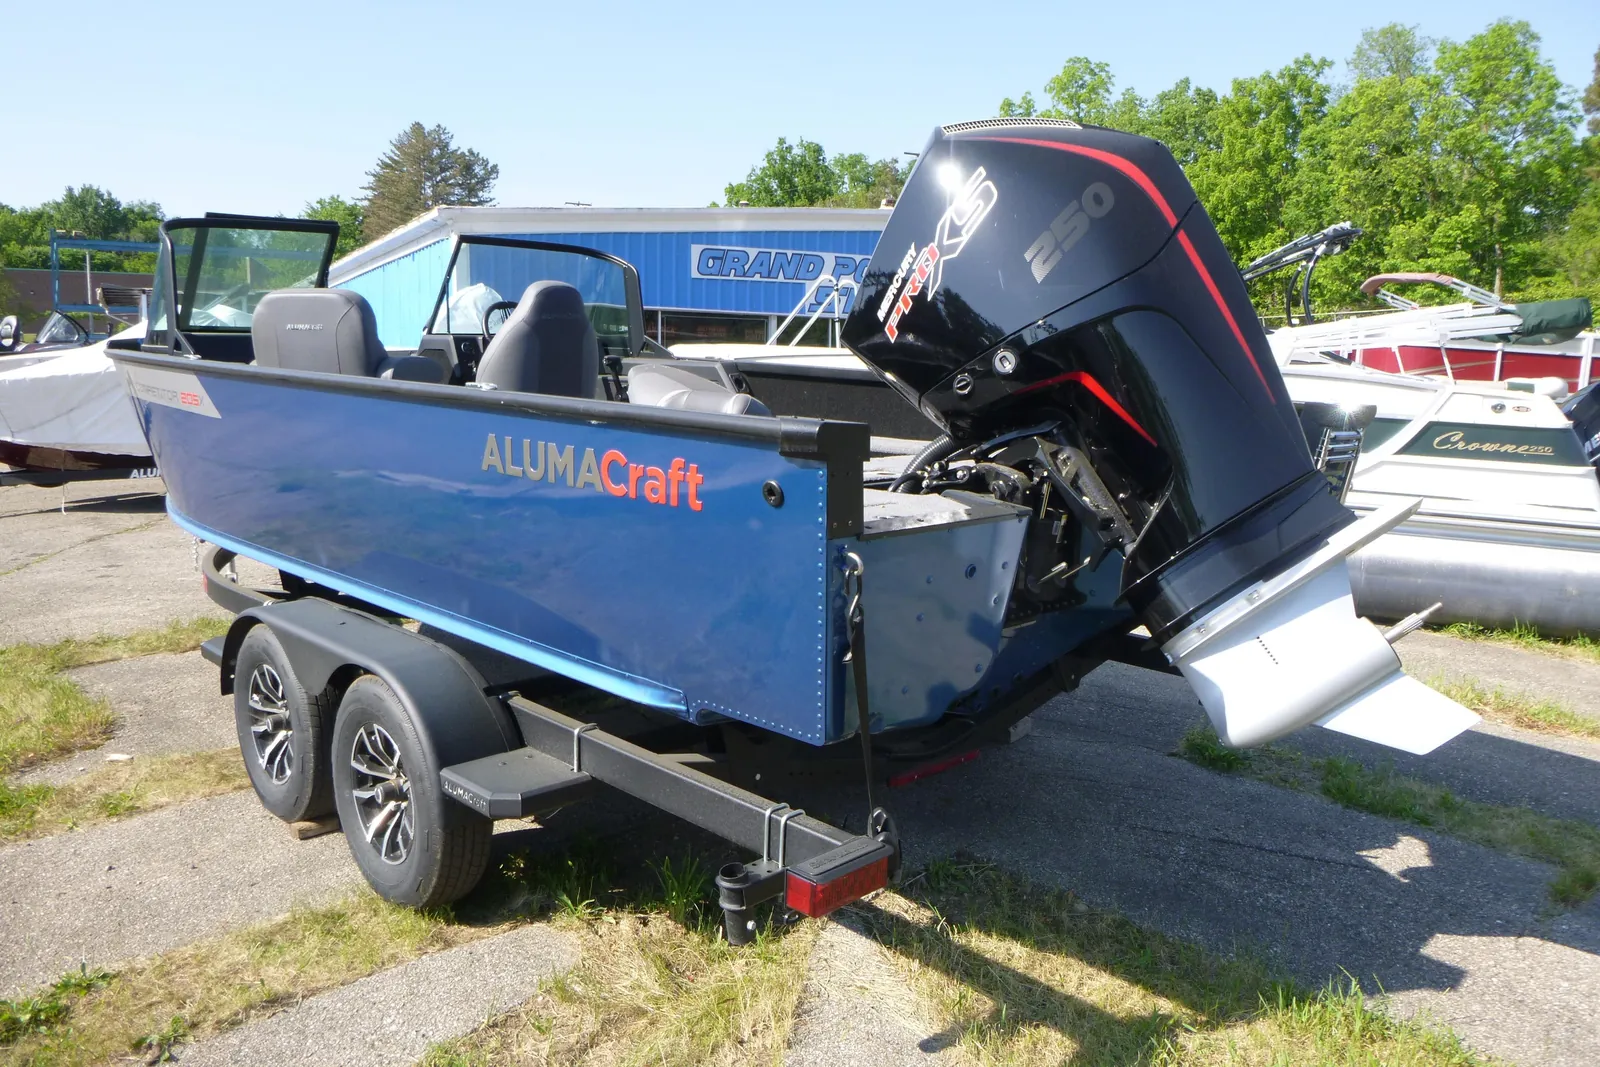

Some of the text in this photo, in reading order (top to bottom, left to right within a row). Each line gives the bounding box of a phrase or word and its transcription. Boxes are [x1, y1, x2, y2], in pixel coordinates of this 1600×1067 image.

[697, 247, 825, 281] GRAND
[1024, 182, 1115, 284] 250
[876, 241, 918, 322] MERCURY
[884, 242, 941, 343] PRO
[481, 432, 704, 512] ALUMACraft
[1433, 431, 1531, 454] Crowne
